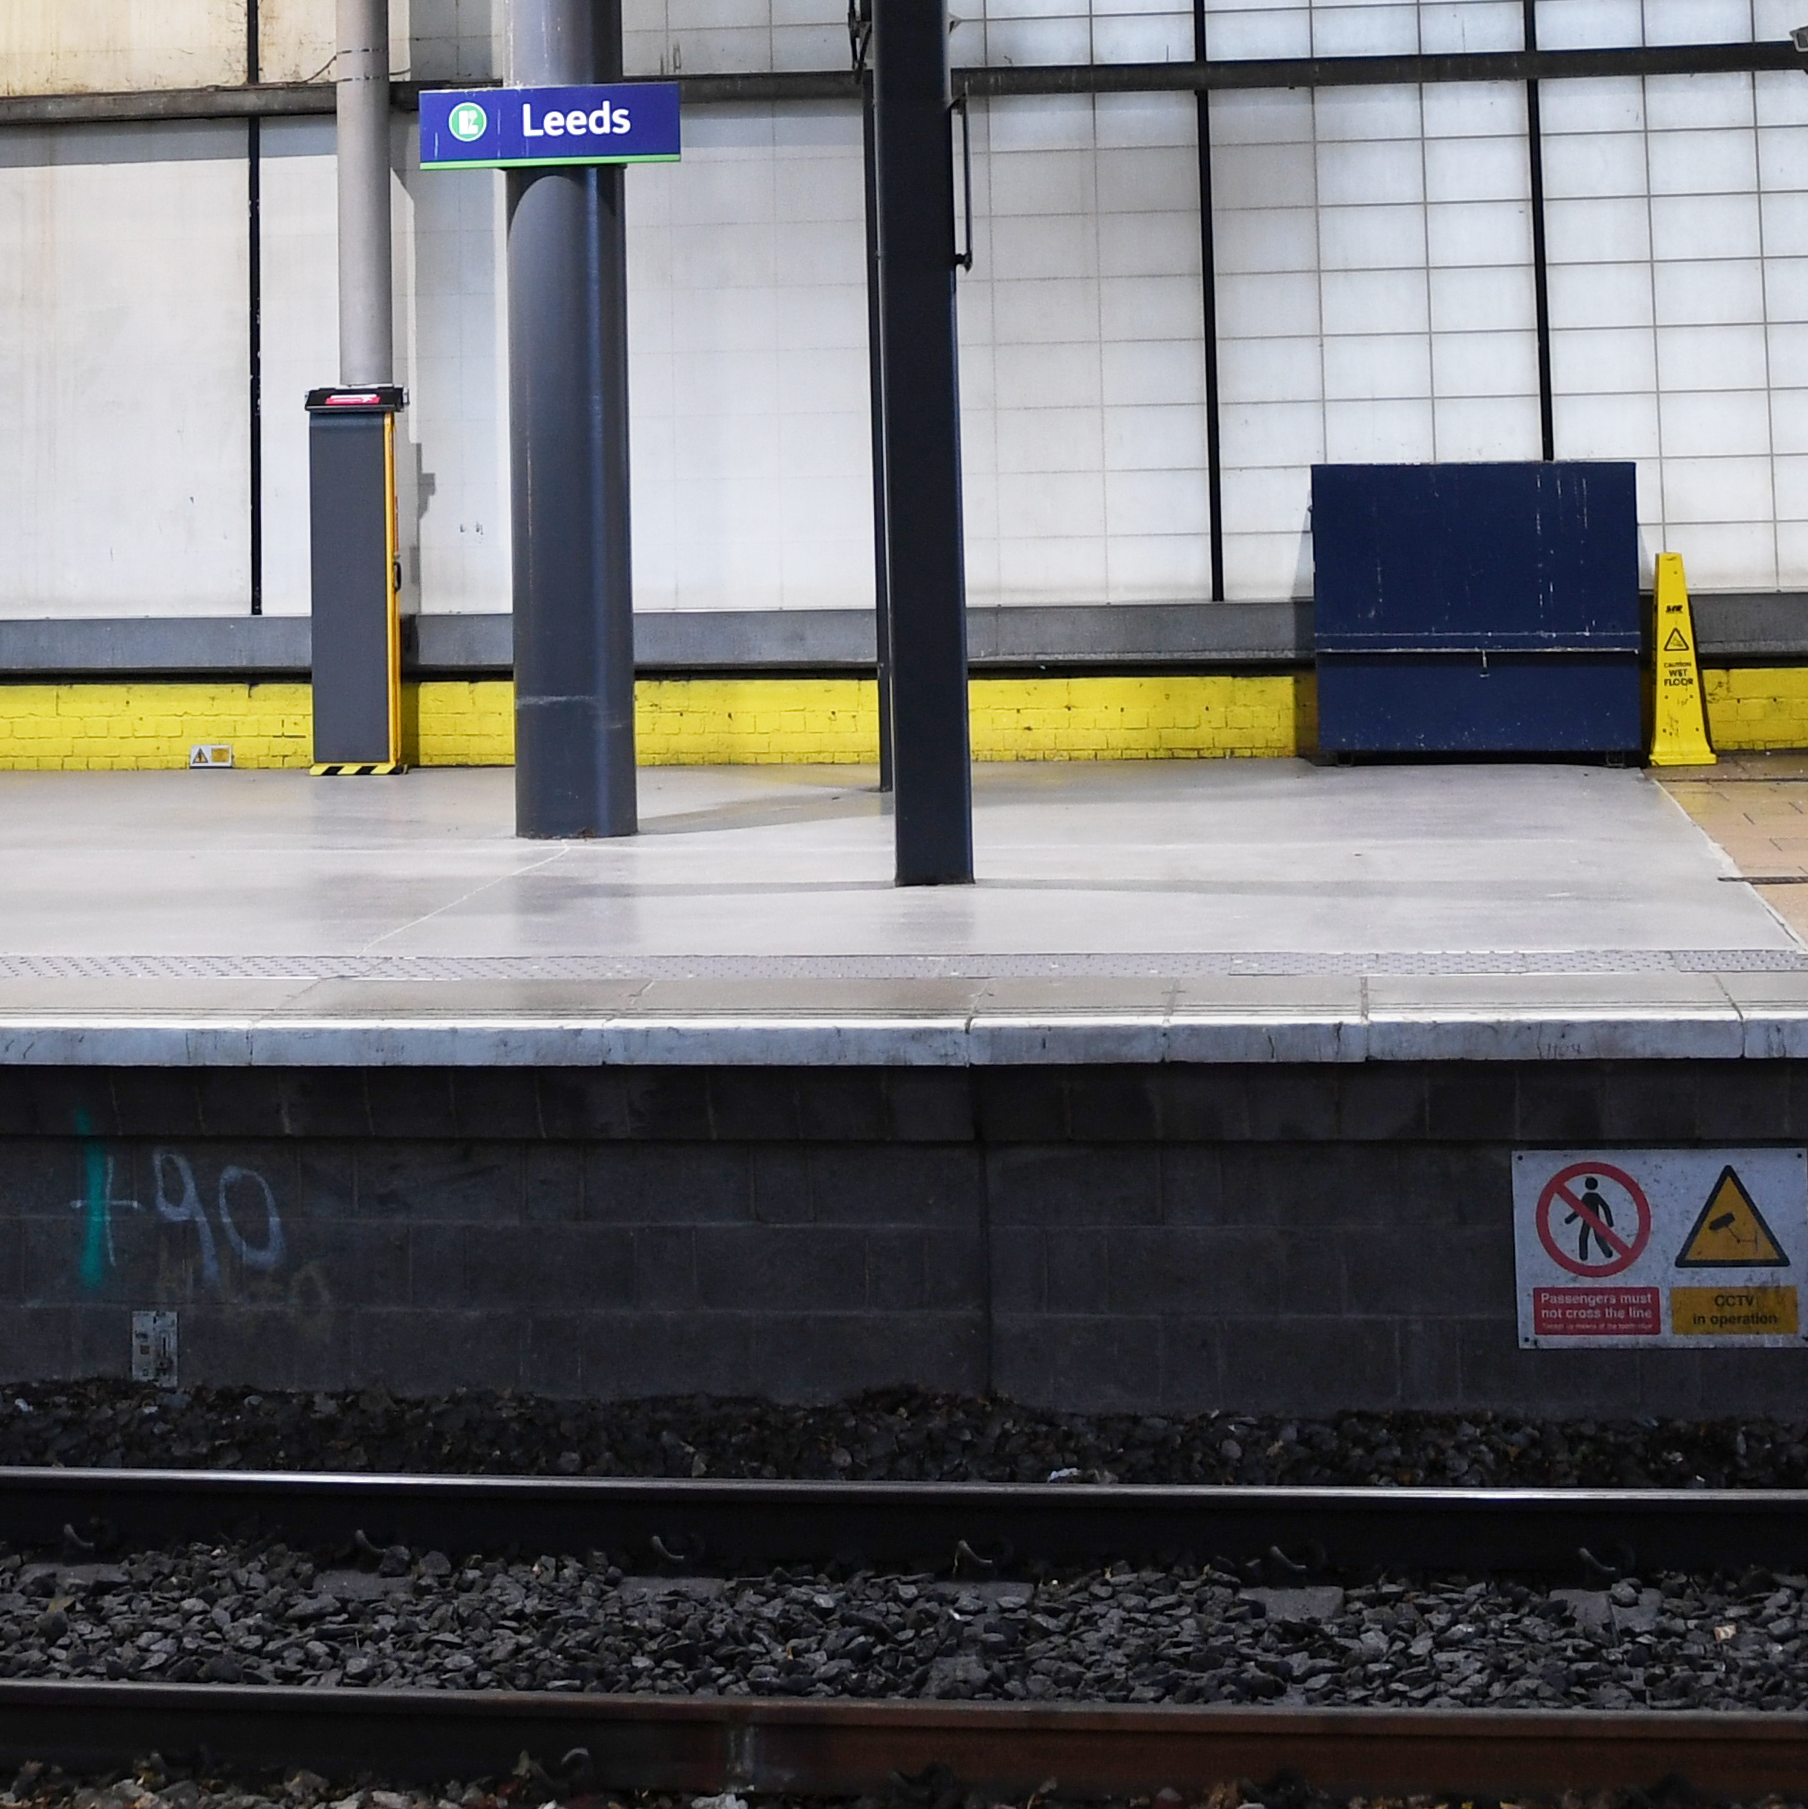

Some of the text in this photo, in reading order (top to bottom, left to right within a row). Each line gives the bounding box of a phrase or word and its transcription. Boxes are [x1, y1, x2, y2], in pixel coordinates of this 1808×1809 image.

[522, 100, 631, 137] Leeds
[1668, 669, 1687, 677] WET
[1663, 678, 1694, 687] FLOOR
[1541, 1292, 1652, 1307] Passengers must
[1714, 1294, 1754, 1307] CCTV
[1541, 1306, 1652, 1319] not cross the line
[1692, 1312, 1778, 1328] in operation
